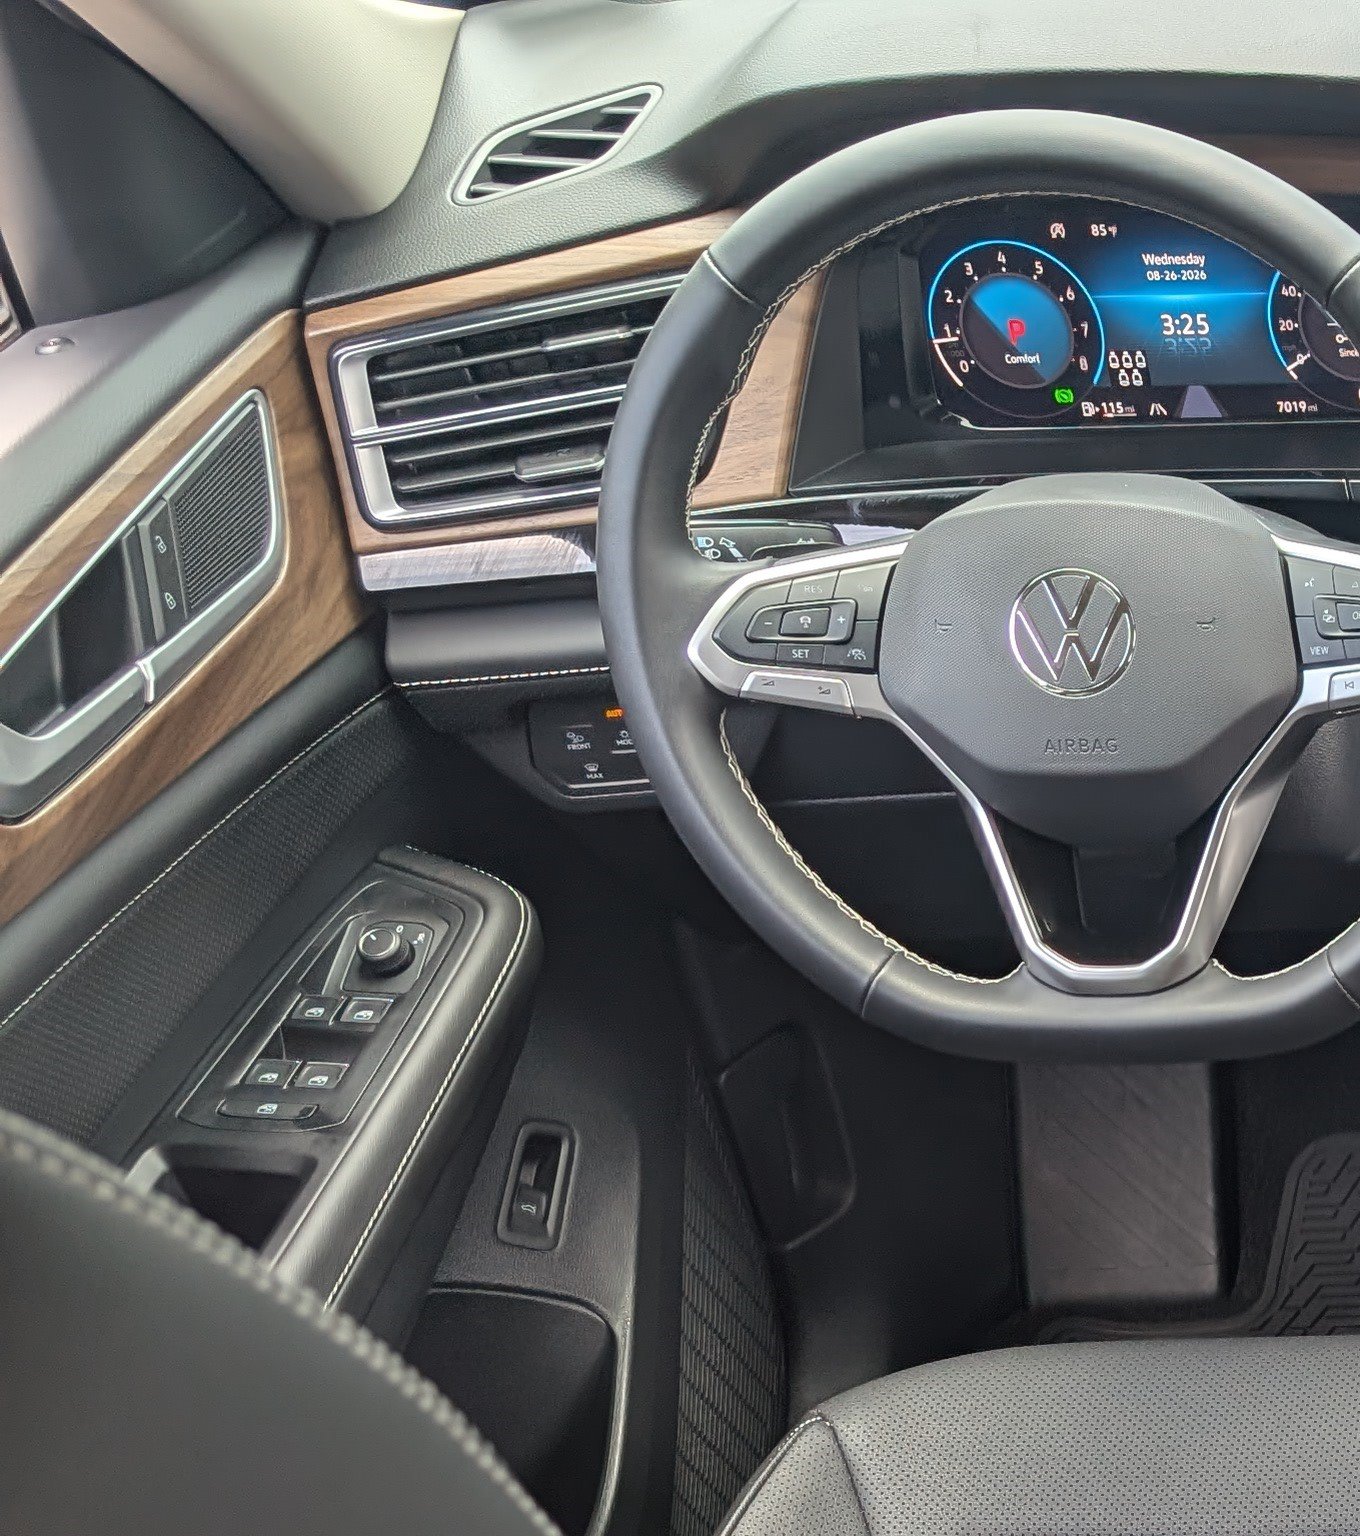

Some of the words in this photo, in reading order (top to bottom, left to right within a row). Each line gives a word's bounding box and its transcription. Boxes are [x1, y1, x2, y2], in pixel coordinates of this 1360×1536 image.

[997, 251, 1006, 264] 4
[1142, 253, 1206, 267] Wednesday
[963, 262, 973, 276] 3
[1034, 260, 1044, 275] 5
[1146, 269, 1207, 281] 08-26-2026
[944, 290, 953, 303] 2
[1066, 285, 1075, 301] 6
[1281, 284, 1296, 297] 40
[943, 323, 951, 337] 1
[1080, 321, 1088, 338] 7
[1160, 313, 1210, 335] 3:25
[1279, 319, 1294, 332] 20
[1009, 319, 1025, 345] P
[1004, 353, 1041, 365] Comfort
[959, 359, 969, 373] 0
[1101, 402, 1124, 414] 115
[1276, 401, 1307, 413] 7019
[804, 584, 823, 594] RES
[791, 650, 810, 659] SET
[1310, 646, 1330, 656] VIEW
[1044, 738, 1119, 755] AIRBAG
[586, 772, 604, 780] MAX
